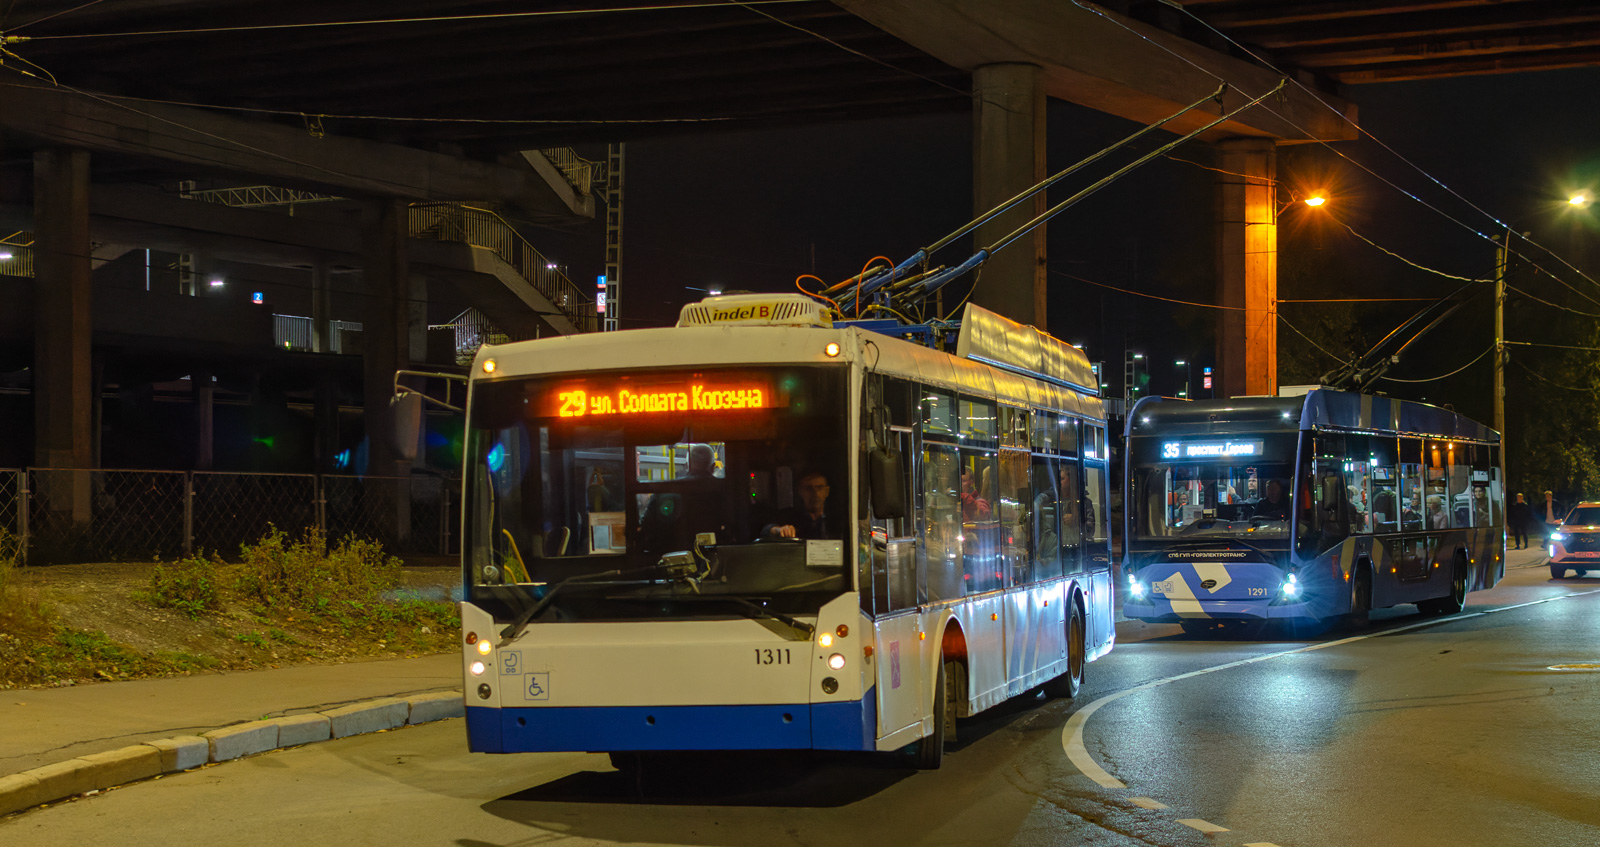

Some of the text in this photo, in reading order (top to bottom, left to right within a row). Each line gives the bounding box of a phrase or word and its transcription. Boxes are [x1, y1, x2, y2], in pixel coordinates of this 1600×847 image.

[255, 293, 261, 301] 2
[713, 306, 769, 321] indel B
[559, 385, 762, 417] 29 ул. Солдата Корзуна
[1163, 443, 1180, 458] 35
[1186, 445, 1224, 456] проспект
[1247, 587, 1268, 596] 1291
[755, 648, 791, 664] 1311
